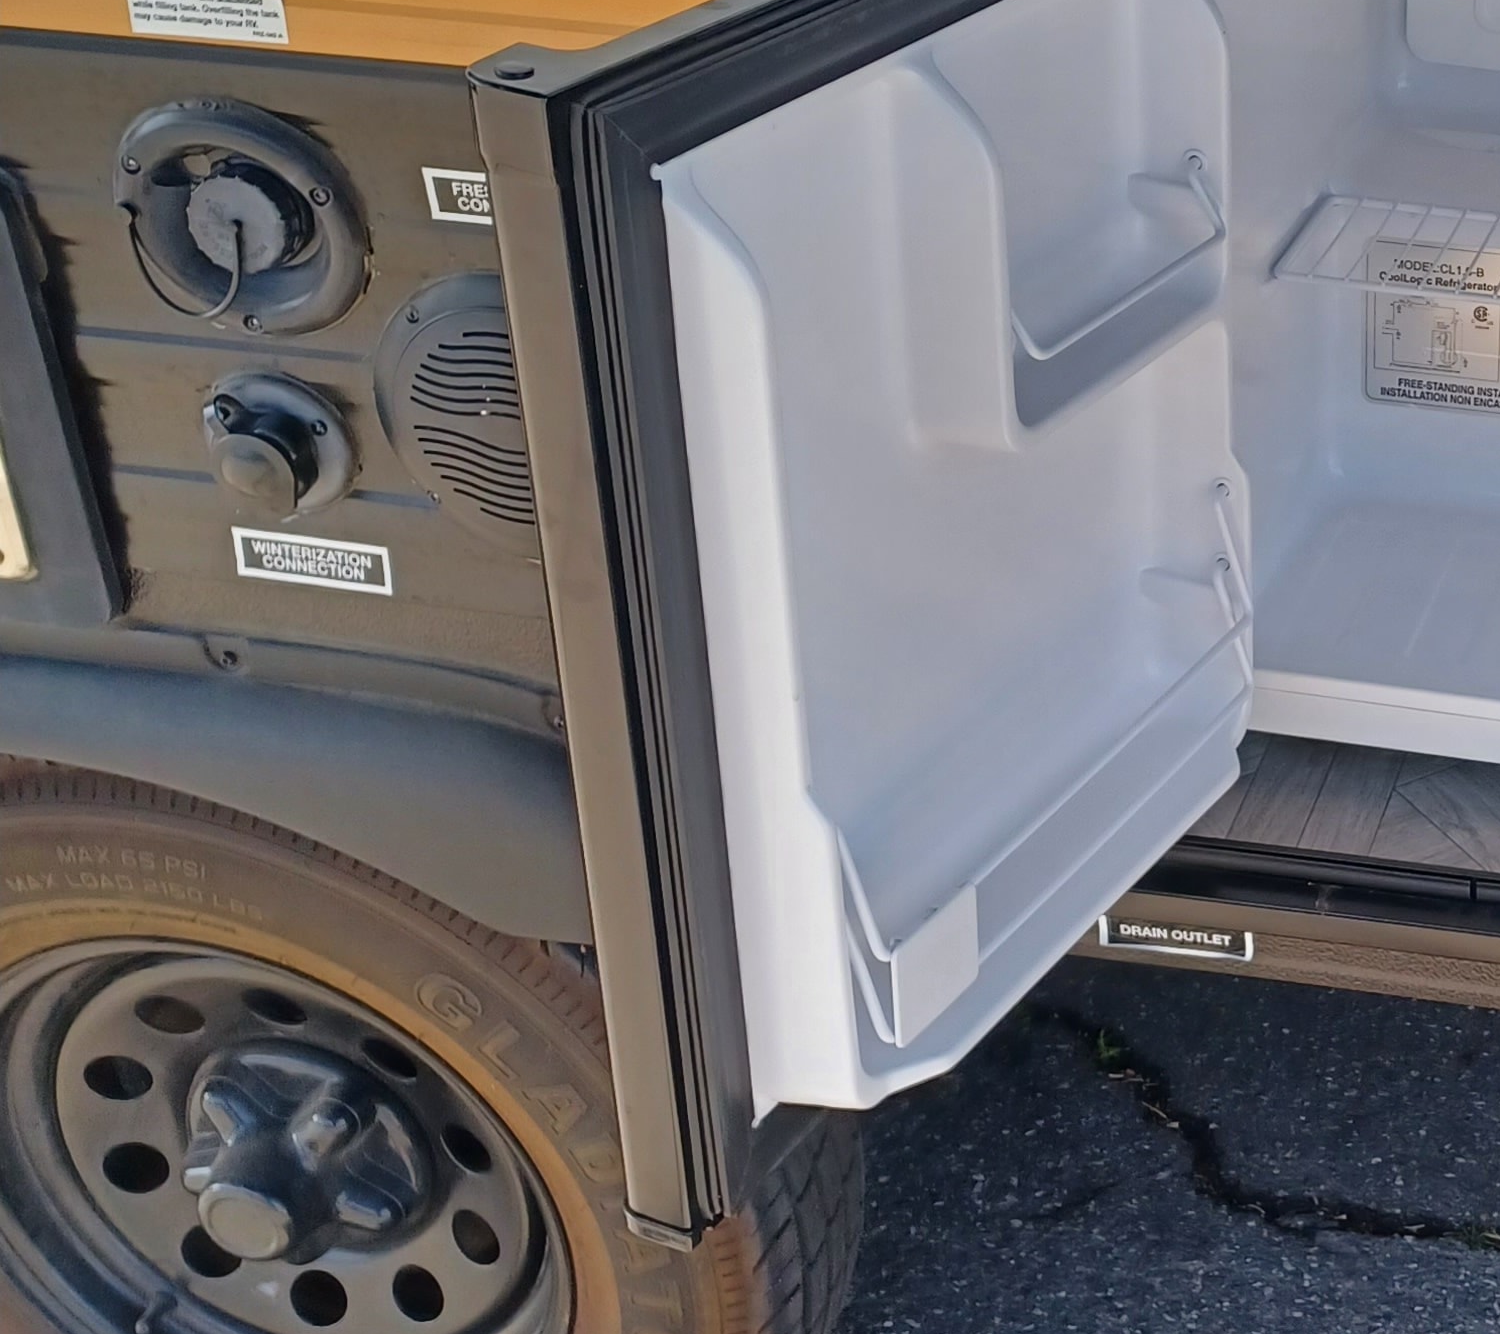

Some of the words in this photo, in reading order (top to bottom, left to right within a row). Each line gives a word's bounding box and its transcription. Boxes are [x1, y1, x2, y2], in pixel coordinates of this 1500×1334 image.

[451, 181, 489, 199] FRE
[1380, 387, 1448, 403] INSTALLATION
[1450, 395, 1472, 406] NON
[1398, 378, 1474, 395] FREE-STANDING
[251, 539, 372, 568] WINTERIZATION
[262, 554, 365, 581] CONNECTION
[56, 845, 110, 865] MAX
[165, 854, 206, 879] PSI
[6, 873, 53, 893] MAX
[65, 871, 133, 892] LOAD
[1119, 923, 1168, 939] DRAIN
[1171, 929, 1232, 946] OUTLET
